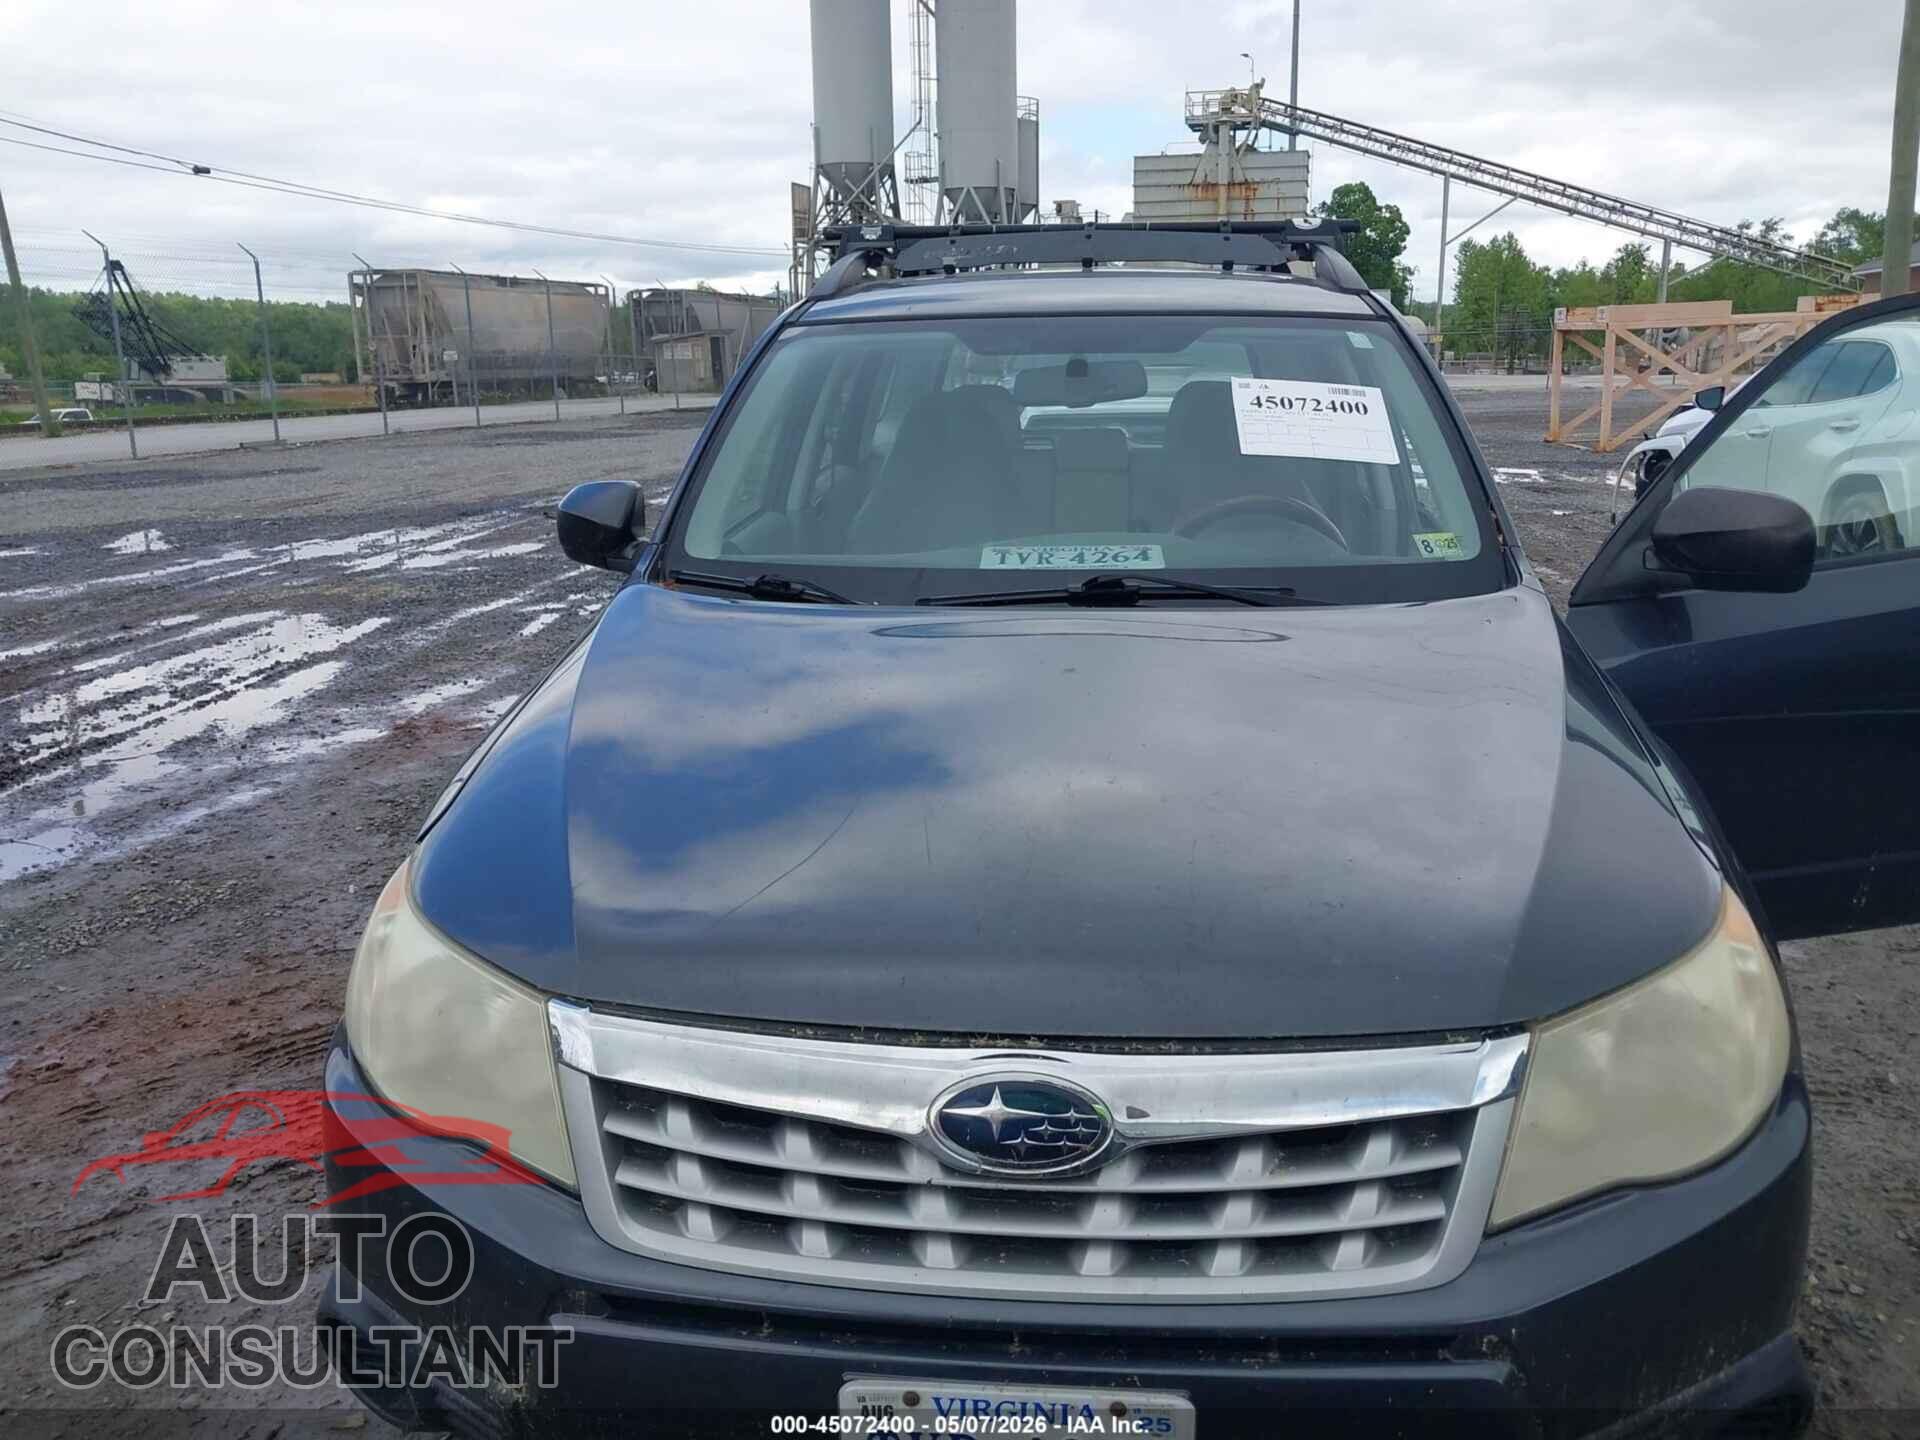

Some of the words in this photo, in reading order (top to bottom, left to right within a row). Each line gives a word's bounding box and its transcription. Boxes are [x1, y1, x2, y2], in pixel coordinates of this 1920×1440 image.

[1249, 395, 1368, 416] 45072400
[1421, 539, 1434, 553] 8
[992, 549, 1151, 565] TVR-4264
[861, 1404, 894, 1422] AUG
[930, 1396, 1096, 1426] VIRGINIA
